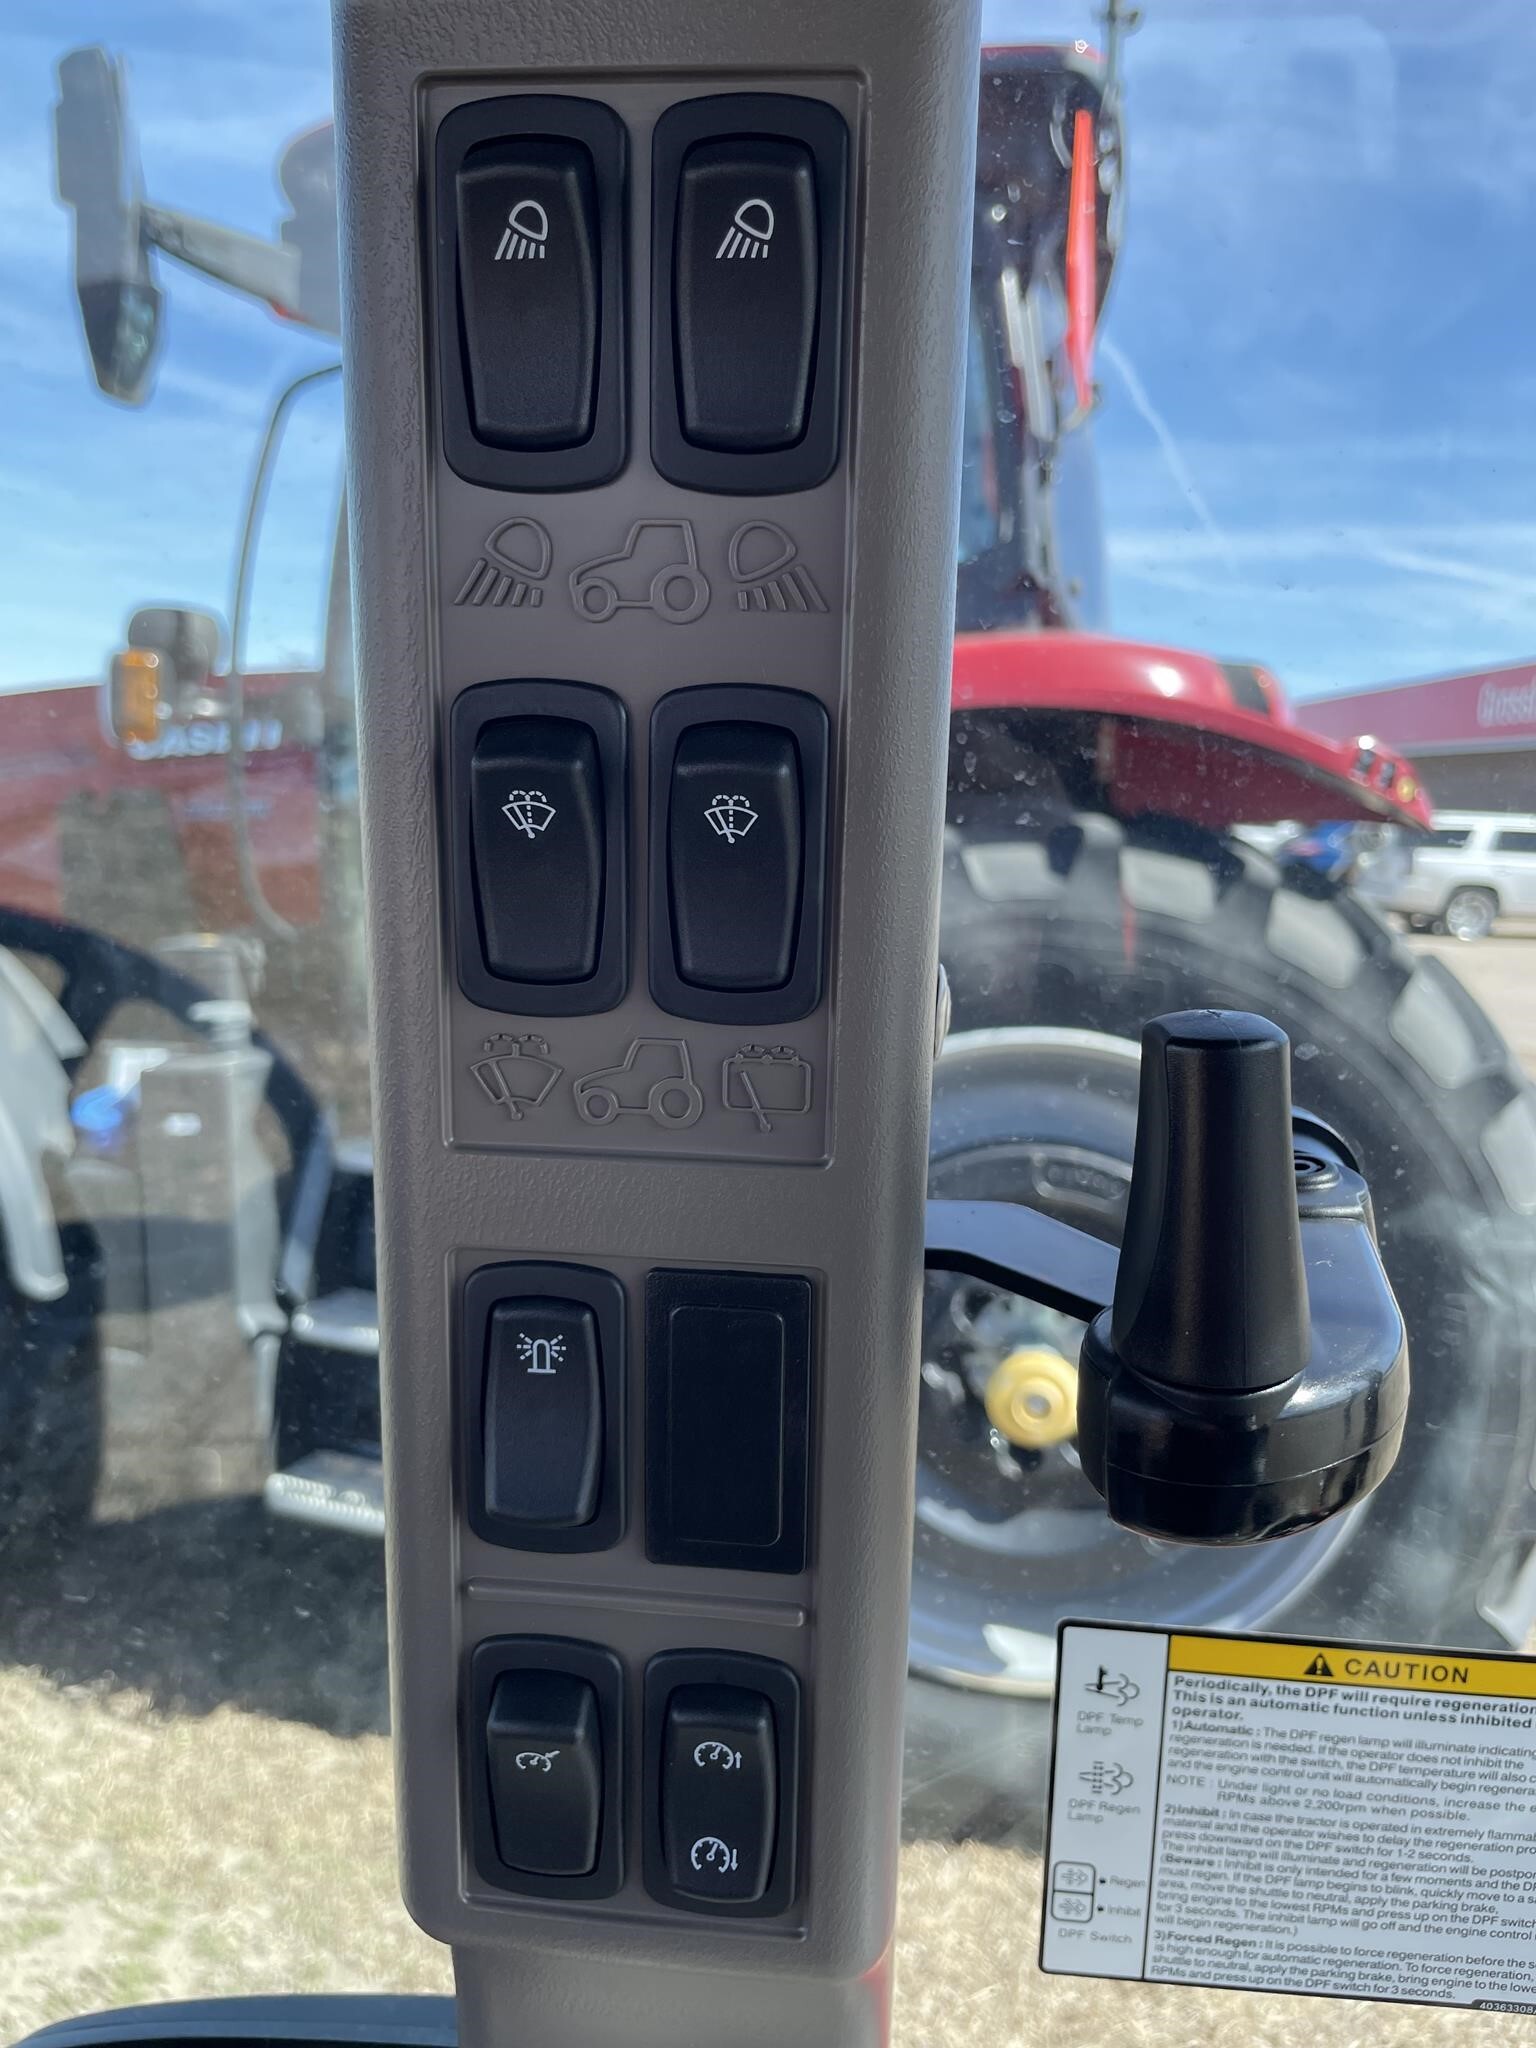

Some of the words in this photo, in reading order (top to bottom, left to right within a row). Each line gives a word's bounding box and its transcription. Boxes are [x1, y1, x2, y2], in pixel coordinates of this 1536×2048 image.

[1345, 1658, 1468, 1683] CAUTION
[1275, 1684, 1300, 1697] the
[1305, 1686, 1339, 1700] DPF
[1341, 1690, 1368, 1702] will
[1372, 1694, 1431, 1707] require
[1173, 1690, 1206, 1704] This
[1210, 1693, 1223, 1705] is
[1227, 1696, 1246, 1707] an
[1249, 1698, 1329, 1713] automatic
[1333, 1703, 1399, 1719] function
[1402, 1710, 1456, 1723] unless
[1460, 1713, 1532, 1729] inhibited
[1172, 1720, 1253, 1736] 1)Automatic
[1406, 1752, 1438, 1764] does
[1463, 1756, 1501, 1769] inhibit
[1504, 1759, 1524, 1771] the
[1398, 1764, 1476, 1779] temperature
[1478, 1770, 1498, 1781] will
[1500, 1772, 1523, 1783] also
[1440, 1780, 1476, 1793] begin
[1478, 1785, 1535, 1797] regenera
[1444, 1796, 1500, 1810] increase
[1504, 1801, 1525, 1812] the
[1164, 1805, 1218, 1818] 2)Inhibit
[1424, 1826, 1484, 1841] extremely
[1377, 1834, 1411, 1848] delay
[1435, 1841, 1513, 1854] regeneration
[1368, 1860, 1446, 1873] regeneration
[1449, 1865, 1468, 1875] will
[1471, 1866, 1486, 1876] be
[1391, 1872, 1411, 1883] few
[1414, 1876, 1472, 1888] moments
[1475, 1879, 1498, 1890] and
[1501, 1880, 1519, 1892] the
[1354, 1895, 1387, 1908] apply
[1390, 1896, 1409, 1907] the
[1412, 1899, 1458, 1913] parking
[1420, 1888, 1464, 1901] quickly
[1466, 1892, 1499, 1902] move
[1503, 1893, 1514, 1903] to
[1517, 1896, 1524, 1904] a
[1313, 1902, 1348, 1915] RPMs
[1351, 1906, 1374, 1917] and
[1377, 1909, 1411, 1920] press
[1413, 1912, 1429, 1923] up
[1432, 1914, 1447, 1923] on
[1450, 1913, 1469, 1925] the
[1471, 1914, 1498, 1927] DPF
[1361, 1920, 1377, 1931] go
[1380, 1920, 1396, 1931] off
[1398, 1922, 1420, 1933] and
[1424, 1923, 1442, 1934] the
[1445, 1926, 1486, 1938] engine
[1489, 1930, 1531, 1941] control
[1154, 1930, 1211, 1944] 3)Forced
[1214, 1935, 1256, 1949] Regen
[1354, 1946, 1384, 1958] force
[1386, 1950, 1463, 1964] regeneration
[1465, 1954, 1504, 1967] before
[1506, 1957, 1525, 1969] the
[1253, 1964, 1286, 1976] apply
[1289, 1965, 1308, 1976] the
[1310, 1968, 1355, 1981] parking
[1398, 1973, 1428, 1987] bring
[1431, 1978, 1472, 1989] engine
[1474, 1979, 1486, 1990] to
[1488, 1980, 1507, 1992] the
[1405, 1962, 1418, 1973] To
[1421, 1963, 1451, 1975] force
[1213, 1973, 1246, 1982] press
[1248, 1976, 1264, 1986] up
[1284, 1976, 1302, 1987] the
[1305, 1978, 1330, 1989] DPF
[1332, 1981, 1370, 1992] switch
[1373, 1983, 1389, 1994] for
[1391, 1985, 1398, 1995] 3
